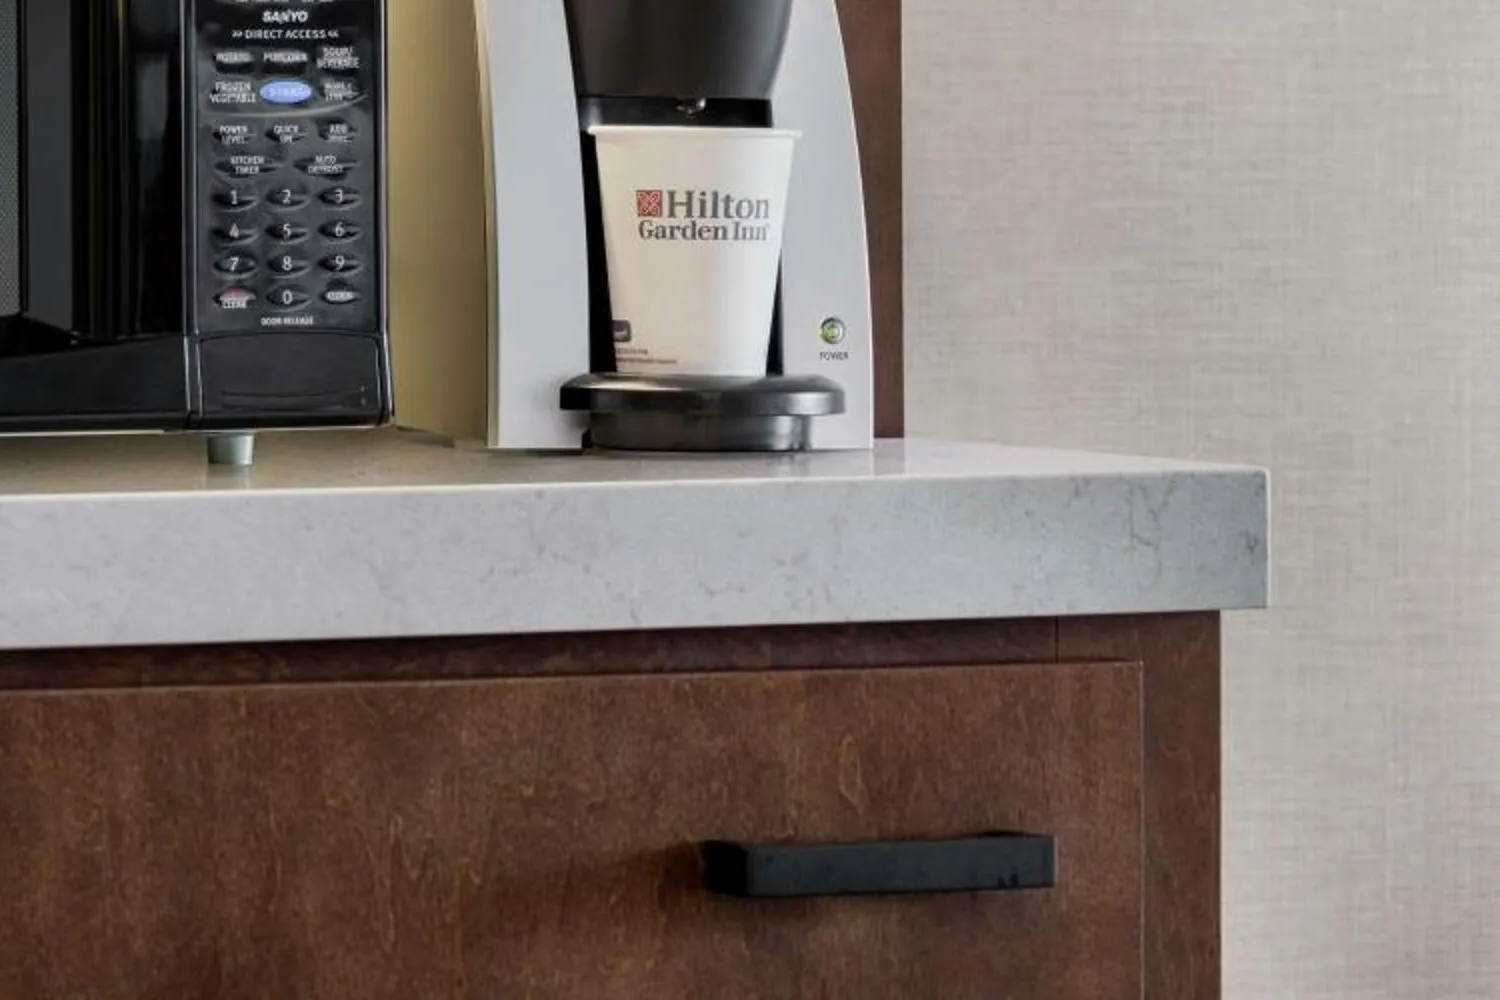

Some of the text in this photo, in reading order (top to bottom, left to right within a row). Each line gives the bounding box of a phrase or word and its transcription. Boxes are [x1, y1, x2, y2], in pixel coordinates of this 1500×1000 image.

[261, 10, 309, 24] SANYO
[245, 29, 327, 39] DIRECT ACCESS
[229, 189, 238, 205] 1
[282, 188, 292, 205] 2
[333, 188, 344, 204] 3
[667, 189, 770, 219] Hilton
[229, 223, 240, 238] 4
[282, 223, 292, 238] 5
[334, 221, 345, 237] 6
[638, 219, 768, 241] Garden Inn
[230, 256, 240, 272] 7
[282, 255, 293, 271] 8
[334, 255, 345, 271] 9
[281, 289, 293, 305] 0
[819, 351, 849, 361] POWER
